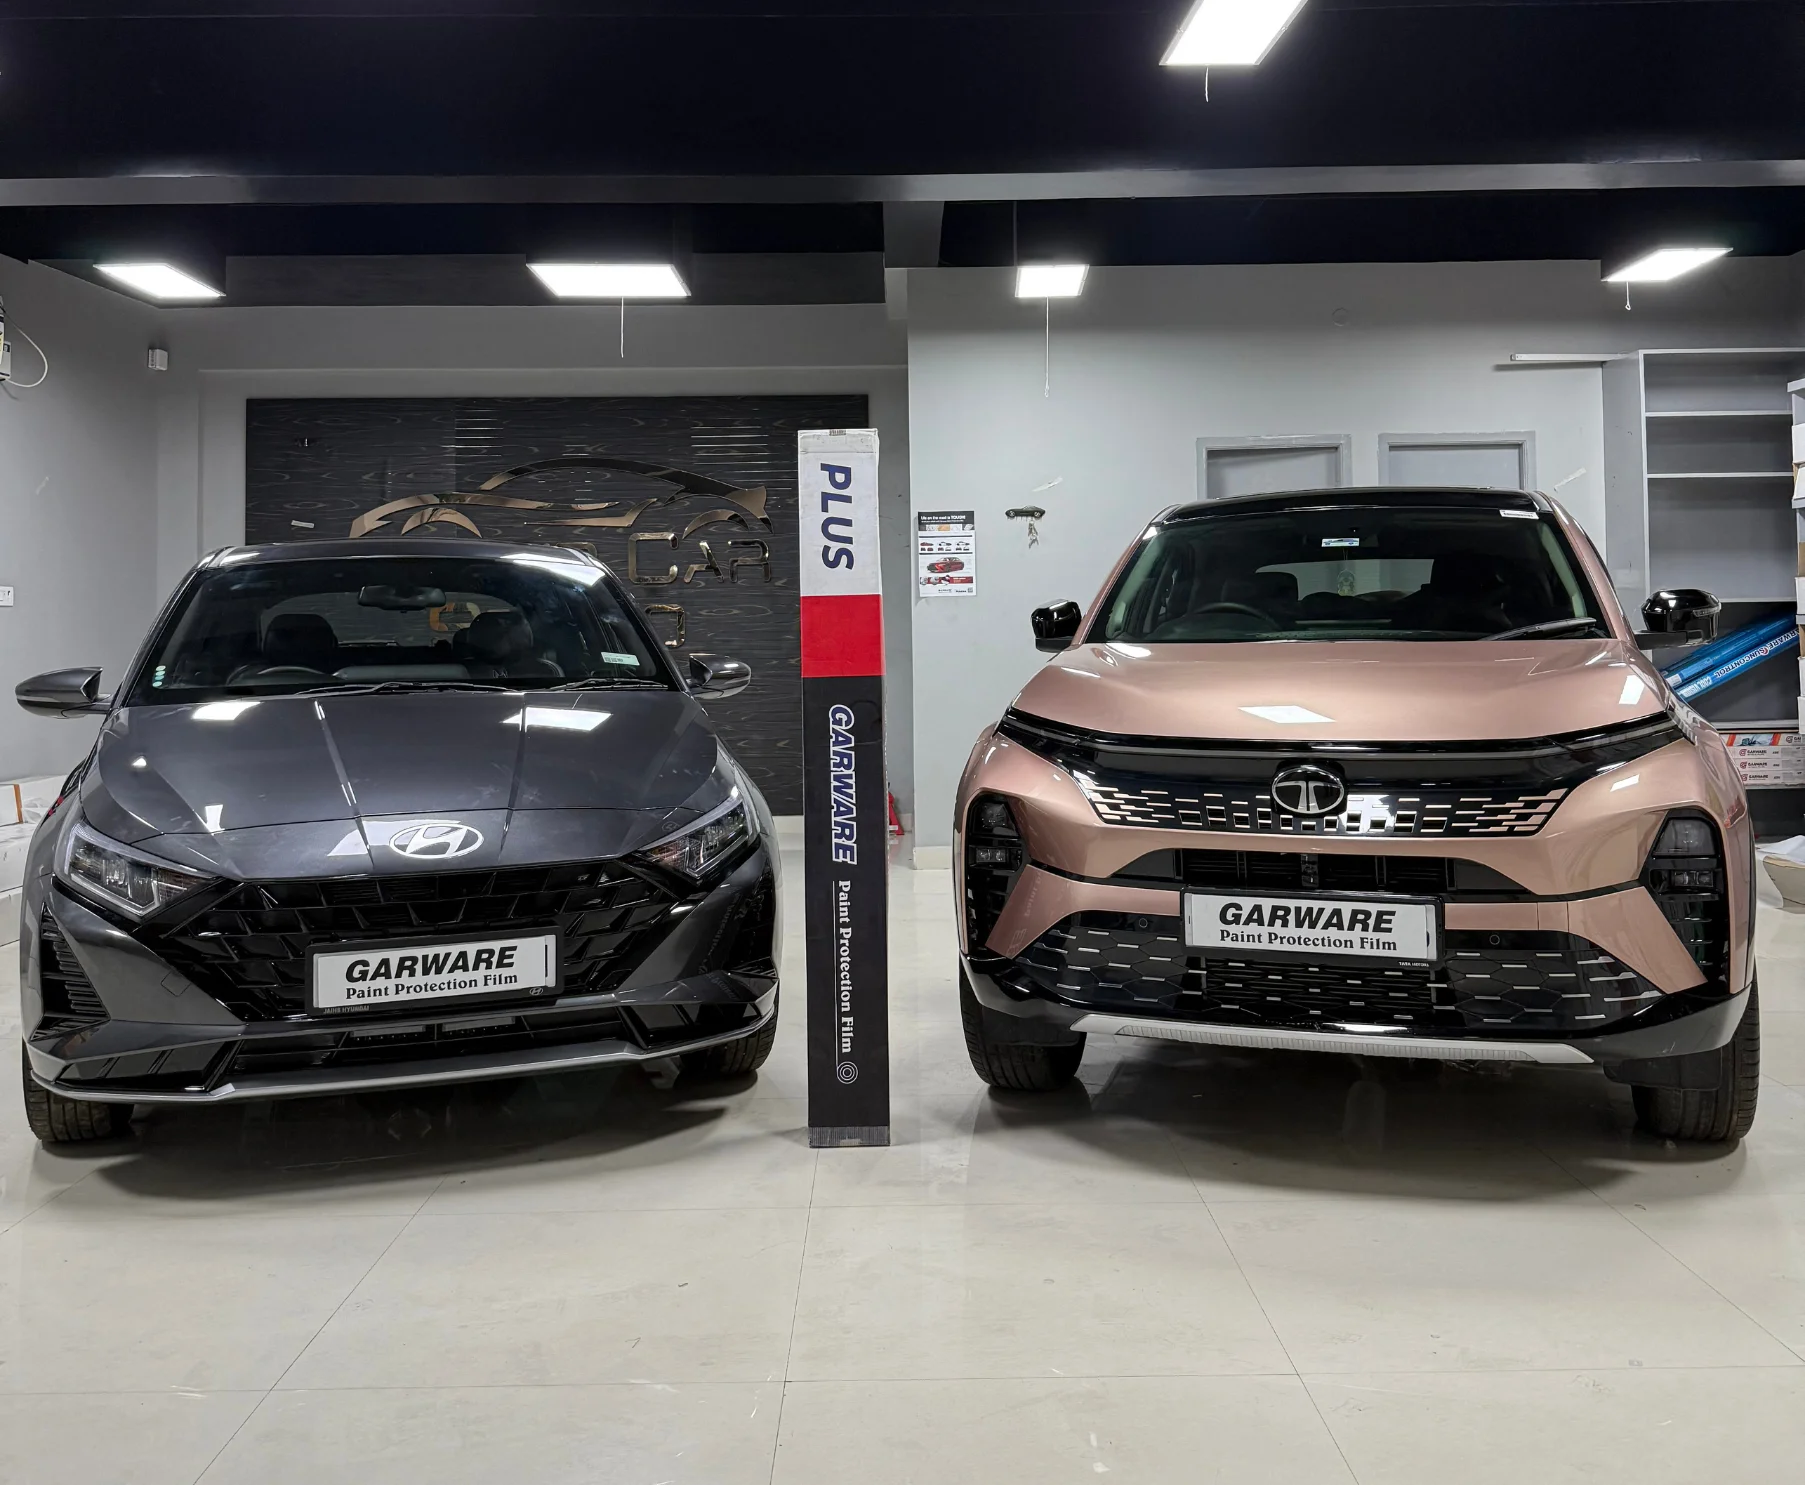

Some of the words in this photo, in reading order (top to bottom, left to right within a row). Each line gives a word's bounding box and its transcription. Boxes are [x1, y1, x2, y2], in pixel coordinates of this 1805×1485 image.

[820, 462, 855, 571] PLUS
[628, 531, 772, 584] CAR
[1769, 629, 1799, 650] ARWARE
[1715, 646, 1765, 678] SUNCONTROL
[829, 704, 858, 865] GARWARE
[838, 879, 851, 924] Paint
[1219, 902, 1396, 934] GARWARE
[1219, 929, 1263, 943] Paint
[1267, 932, 1354, 949] Protection
[1359, 936, 1397, 951] Film
[345, 945, 518, 983] GARWARE
[839, 927, 855, 1013] Protection
[345, 985, 390, 1000] Paint
[394, 978, 478, 996] Protection
[483, 972, 518, 987] Film
[841, 1016, 855, 1053] Film
